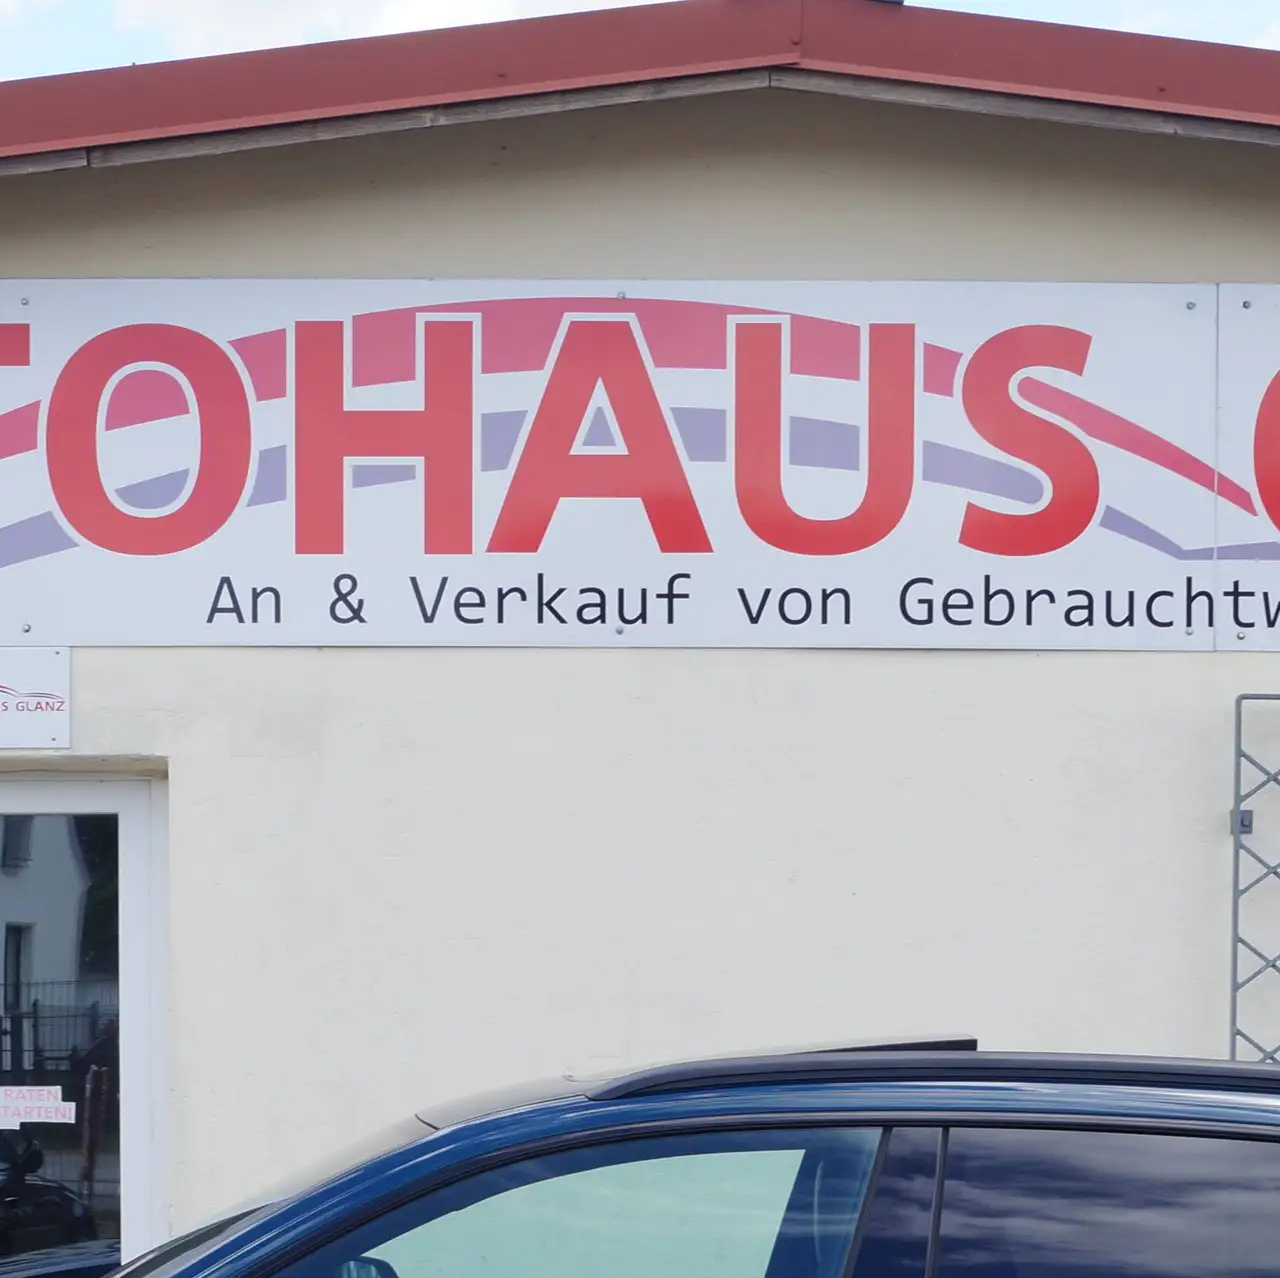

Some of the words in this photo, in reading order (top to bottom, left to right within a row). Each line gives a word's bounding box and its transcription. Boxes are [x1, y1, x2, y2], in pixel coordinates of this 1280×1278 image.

[206, 575, 282, 625] An
[328, 573, 368, 625] &
[410, 572, 692, 625] Verkauf
[737, 586, 852, 626] von
[15, 701, 66, 712] GLANZ
[4, 1087, 60, 1102] RATEN
